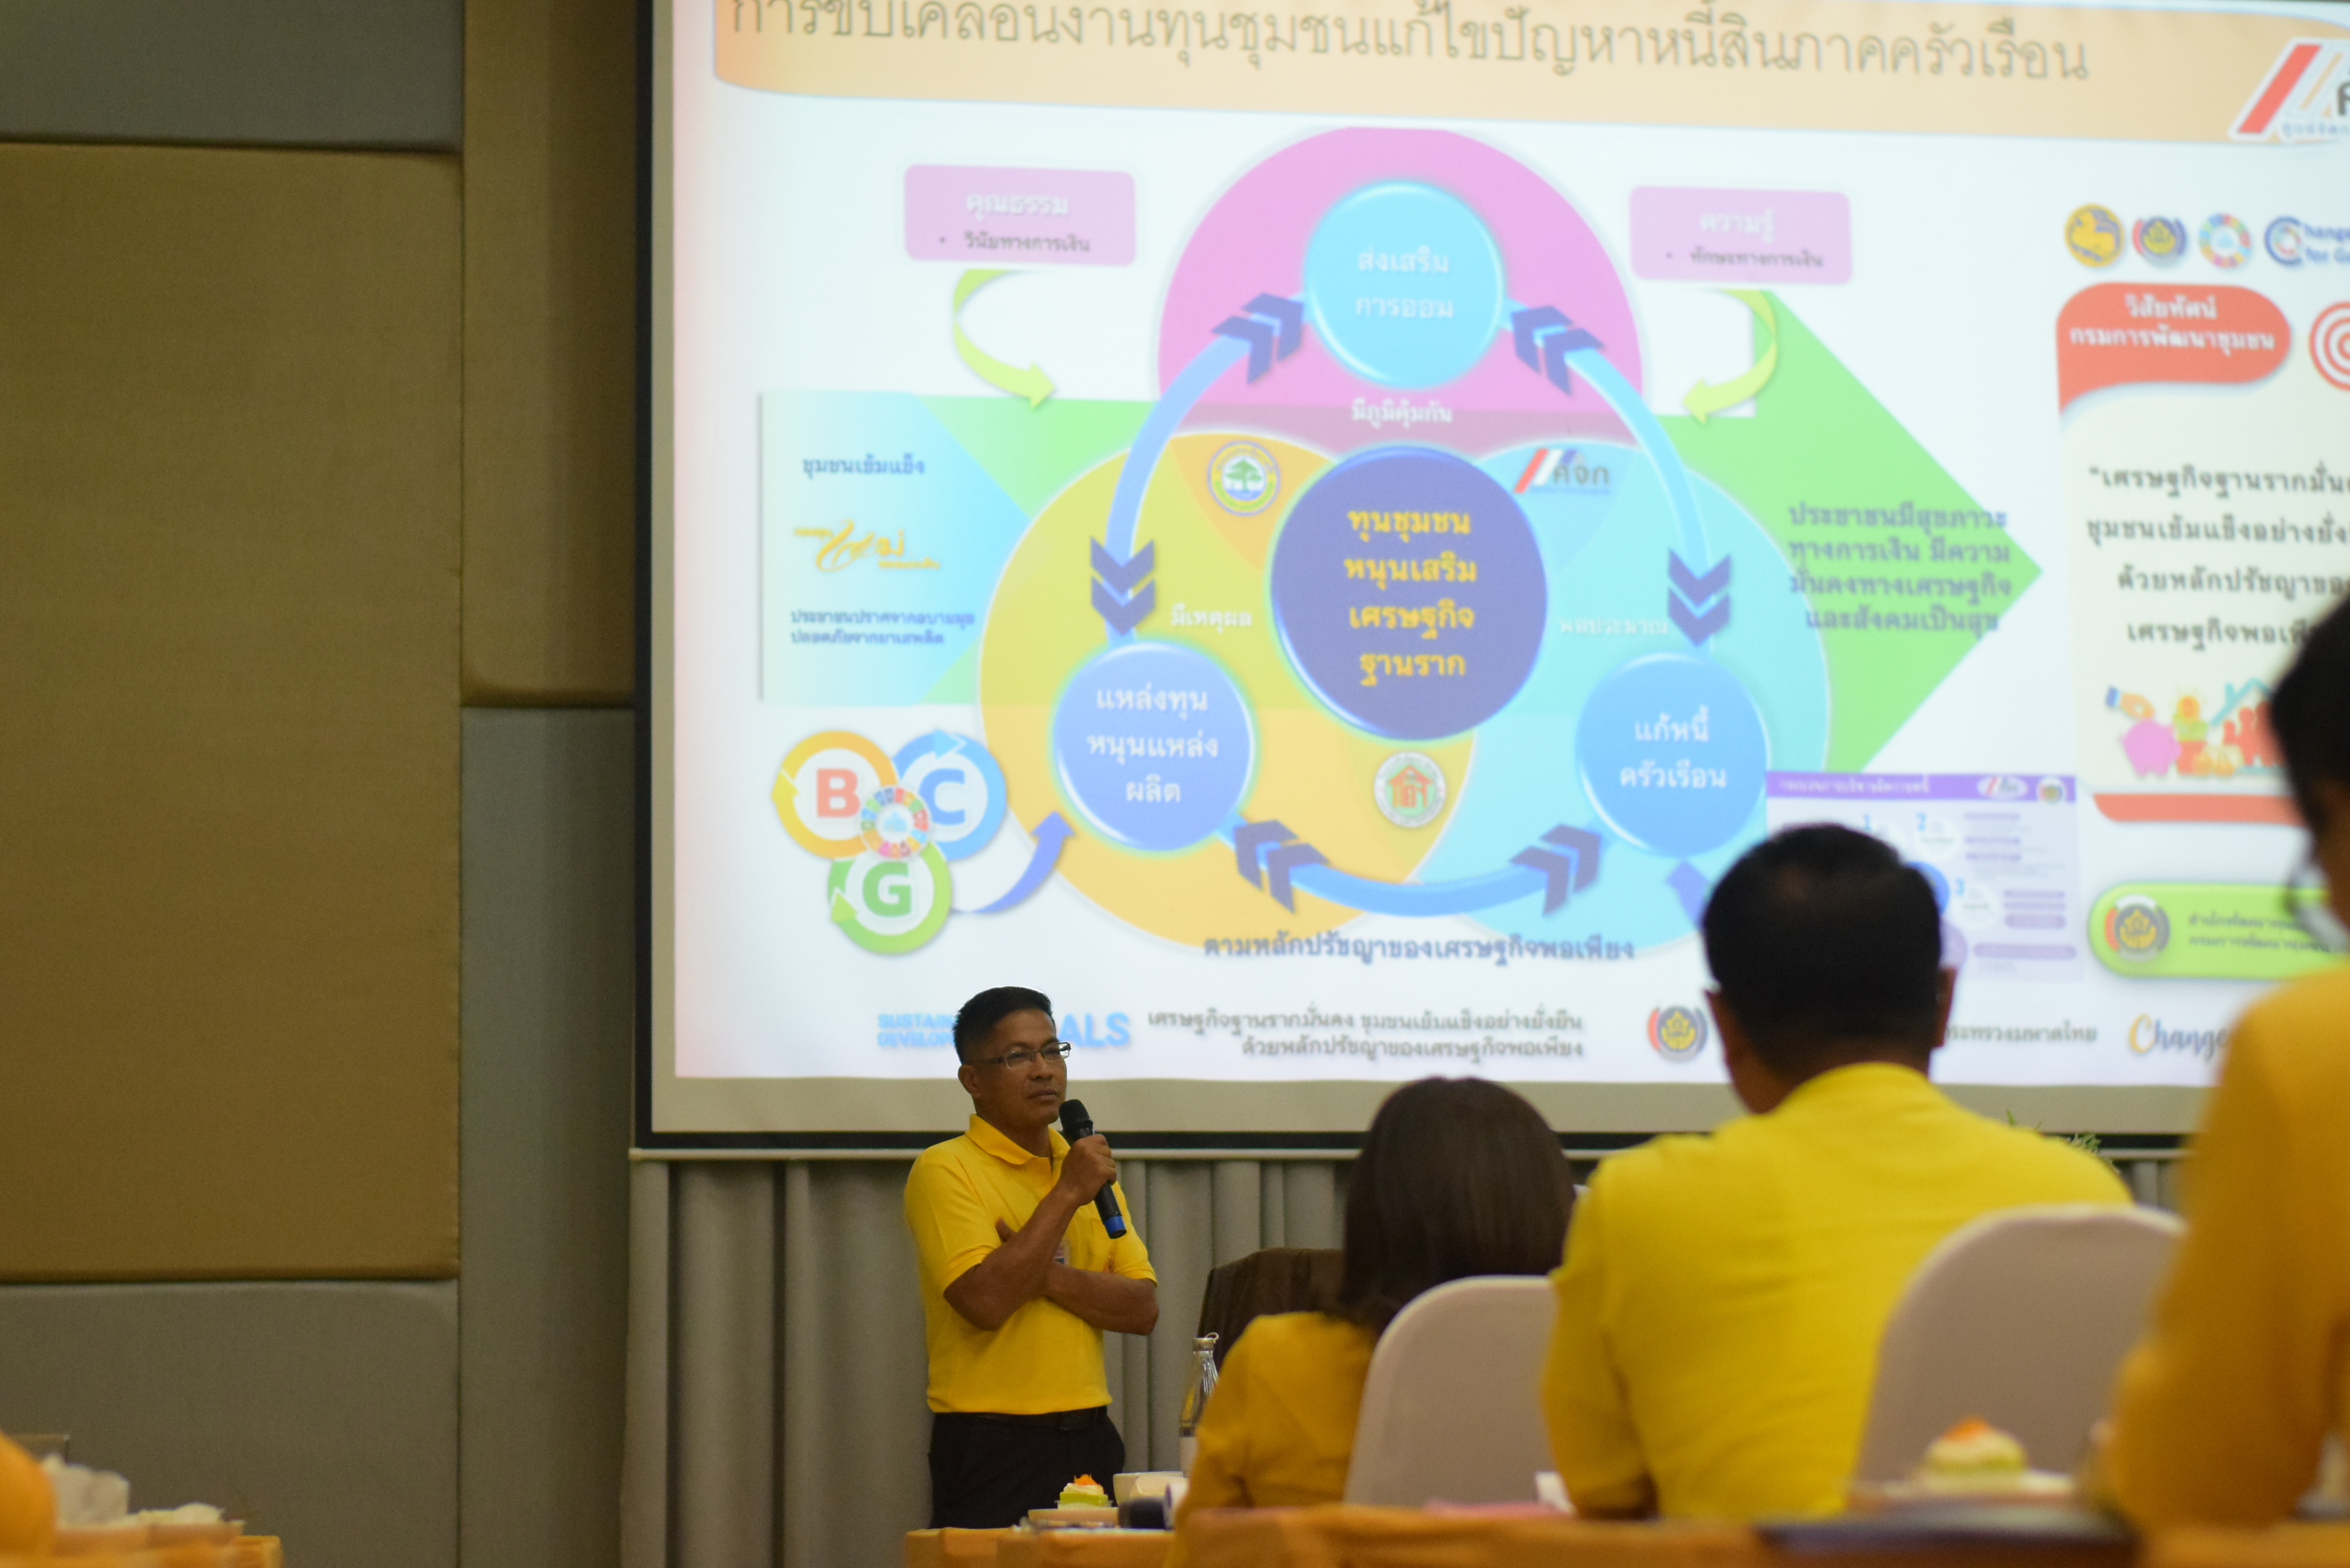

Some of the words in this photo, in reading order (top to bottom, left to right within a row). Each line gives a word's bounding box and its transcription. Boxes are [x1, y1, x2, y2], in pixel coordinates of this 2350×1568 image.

[1358, 246, 1450, 274] ส่งเสริม
[1355, 295, 1454, 320] การออม
[1347, 510, 1471, 541] ทุนชุมชน
[1344, 551, 1477, 590] หนุนเสริม
[1350, 599, 1475, 639] เศรษฐกิจ
[1360, 653, 1466, 686] ฐานราก
[1097, 686, 1207, 719] แหล่งทุน
[1635, 706, 1709, 742] แก้หนี้
[1087, 731, 1219, 764] หนุนแหล่ง
[1126, 775, 1181, 803] ผลิต
[1620, 760, 1727, 789] ครัวเรือน
[816, 768, 860, 817] B
[918, 767, 966, 826] C
[862, 861, 913, 917] G
[878, 1013, 959, 1029] SUSTAIN
[1058, 1011, 1130, 1046] ALS
[878, 1032, 954, 1047] DEVELOP
